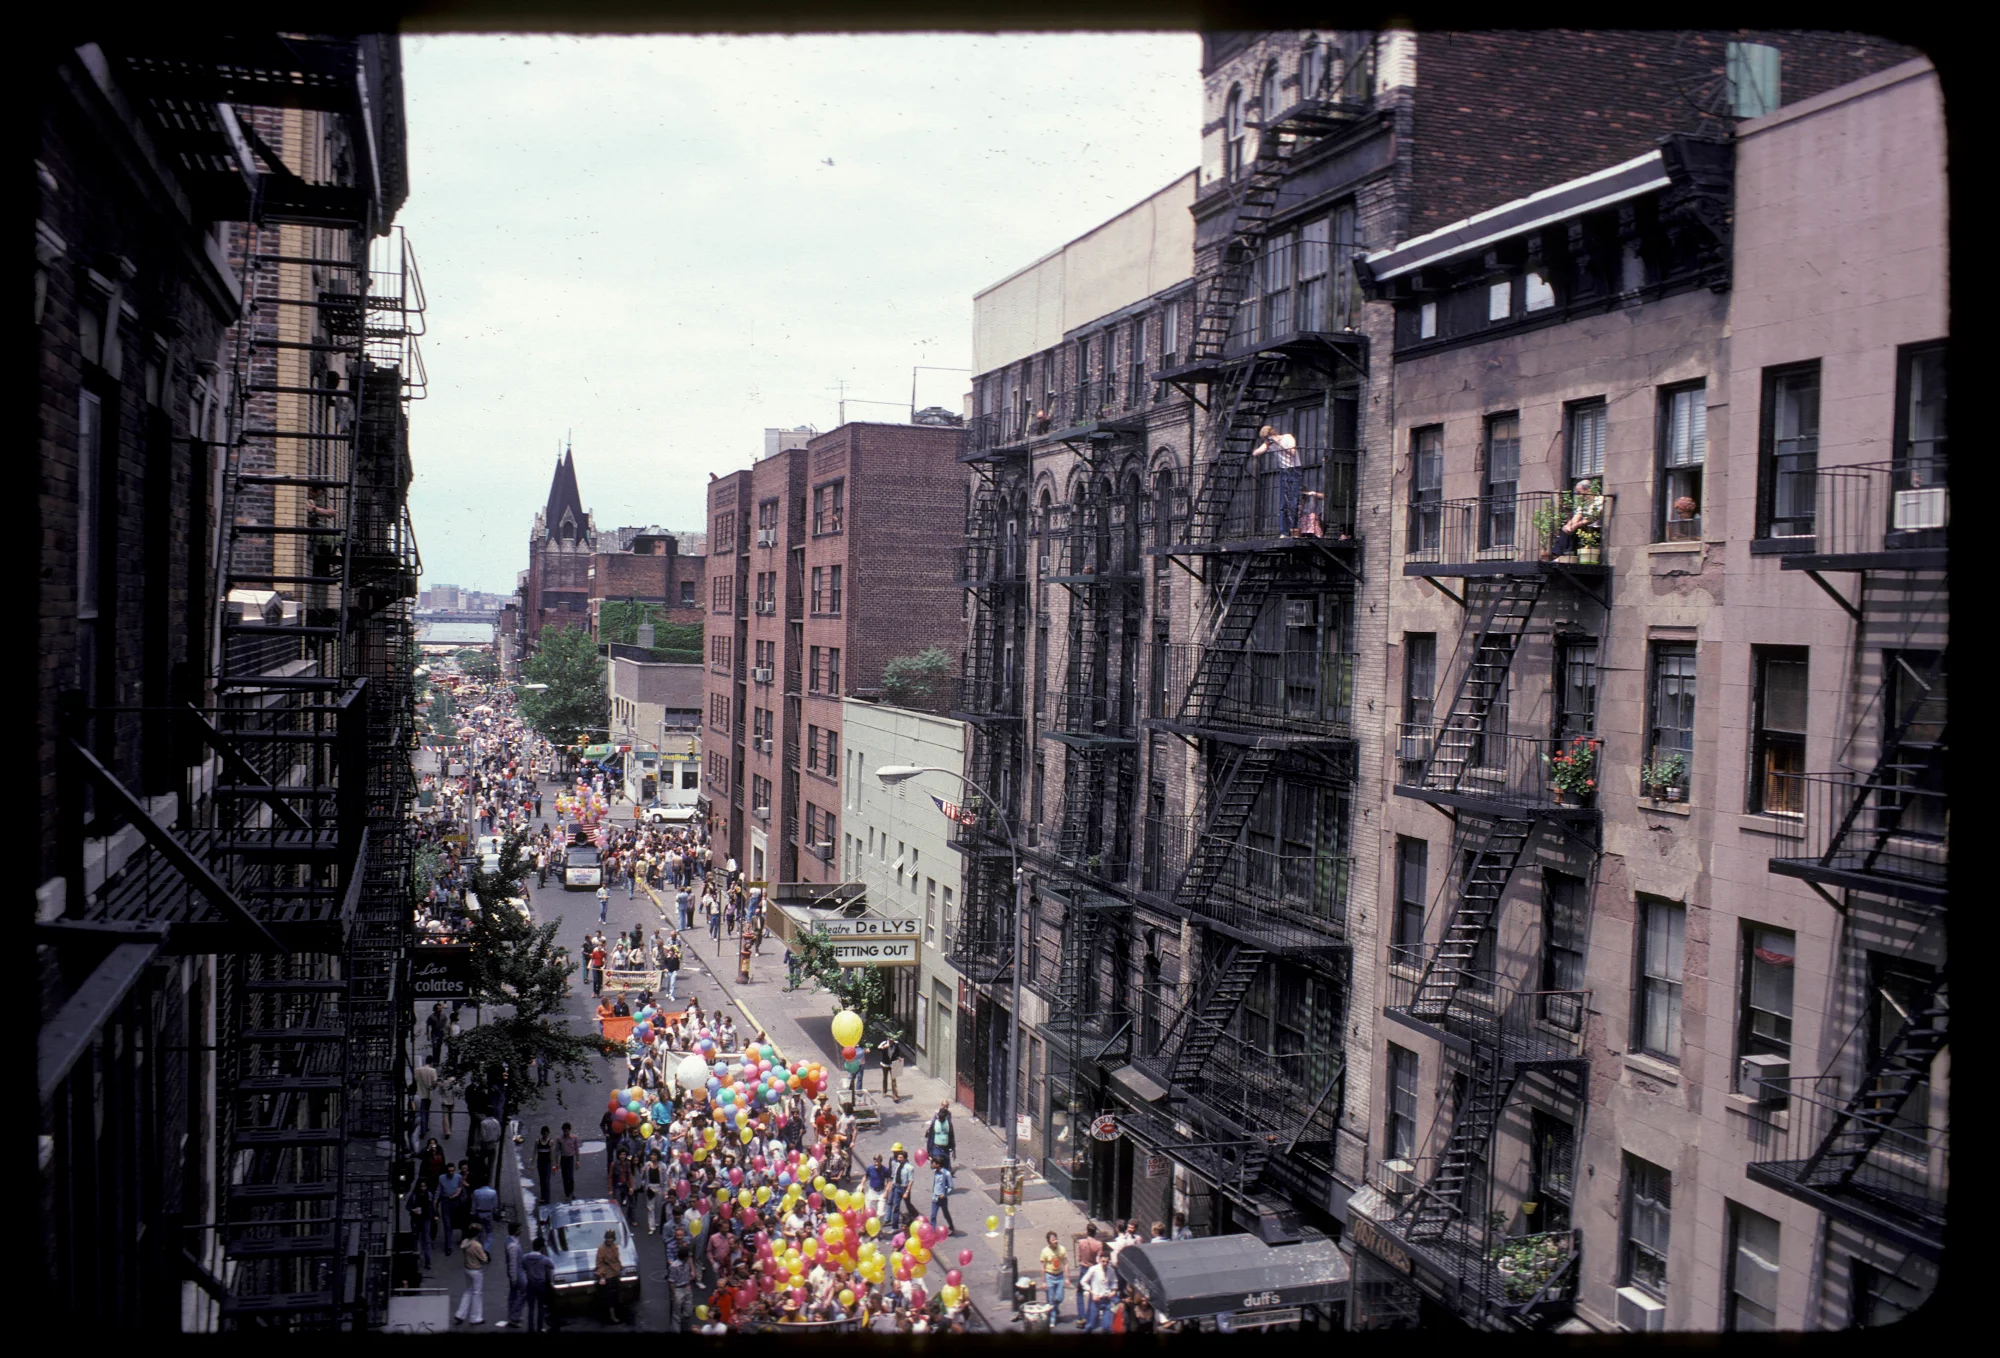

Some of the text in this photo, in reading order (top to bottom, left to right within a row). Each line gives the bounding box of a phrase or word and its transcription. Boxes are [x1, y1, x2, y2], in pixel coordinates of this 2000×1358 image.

[815, 920, 916, 934] heatre De LYS
[833, 945, 909, 957] ETTING OUT
[1148, 1157, 1168, 1165] LOFT
